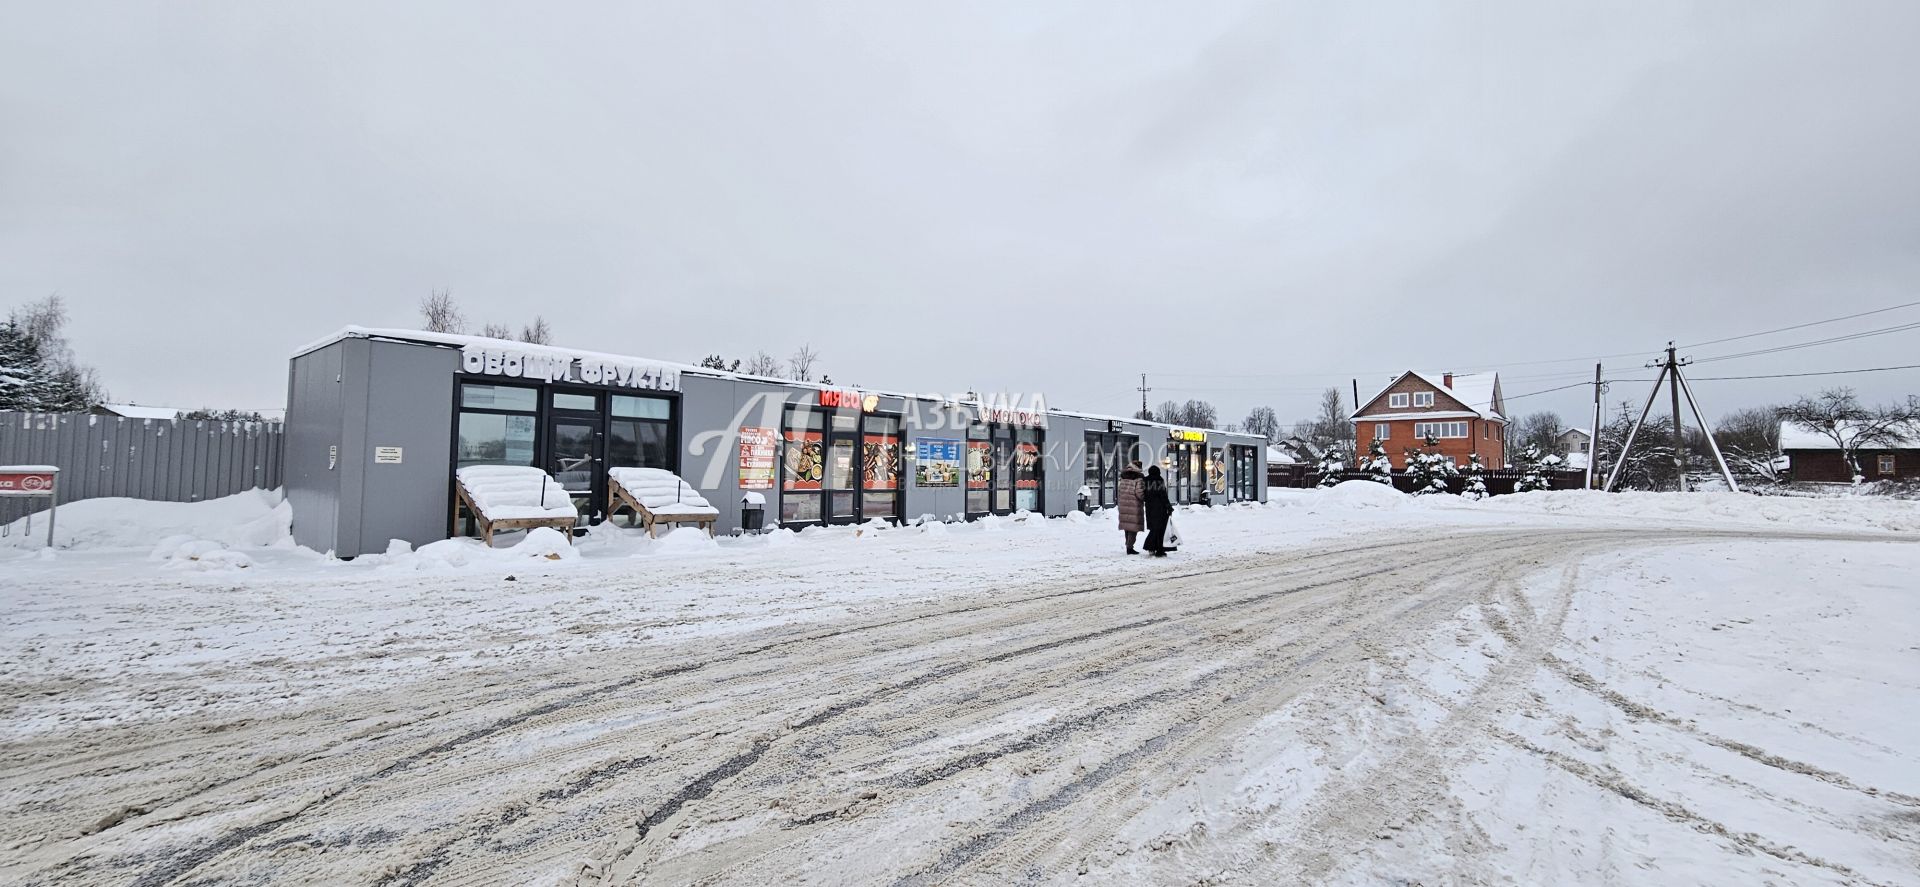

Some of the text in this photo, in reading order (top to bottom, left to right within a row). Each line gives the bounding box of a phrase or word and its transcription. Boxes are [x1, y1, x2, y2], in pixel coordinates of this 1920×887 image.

[462, 349, 682, 392] ОВОЩИ ФРУКТЫ
[819, 390, 860, 409] МЯСО
[992, 409, 1041, 426] МОЛОКО
